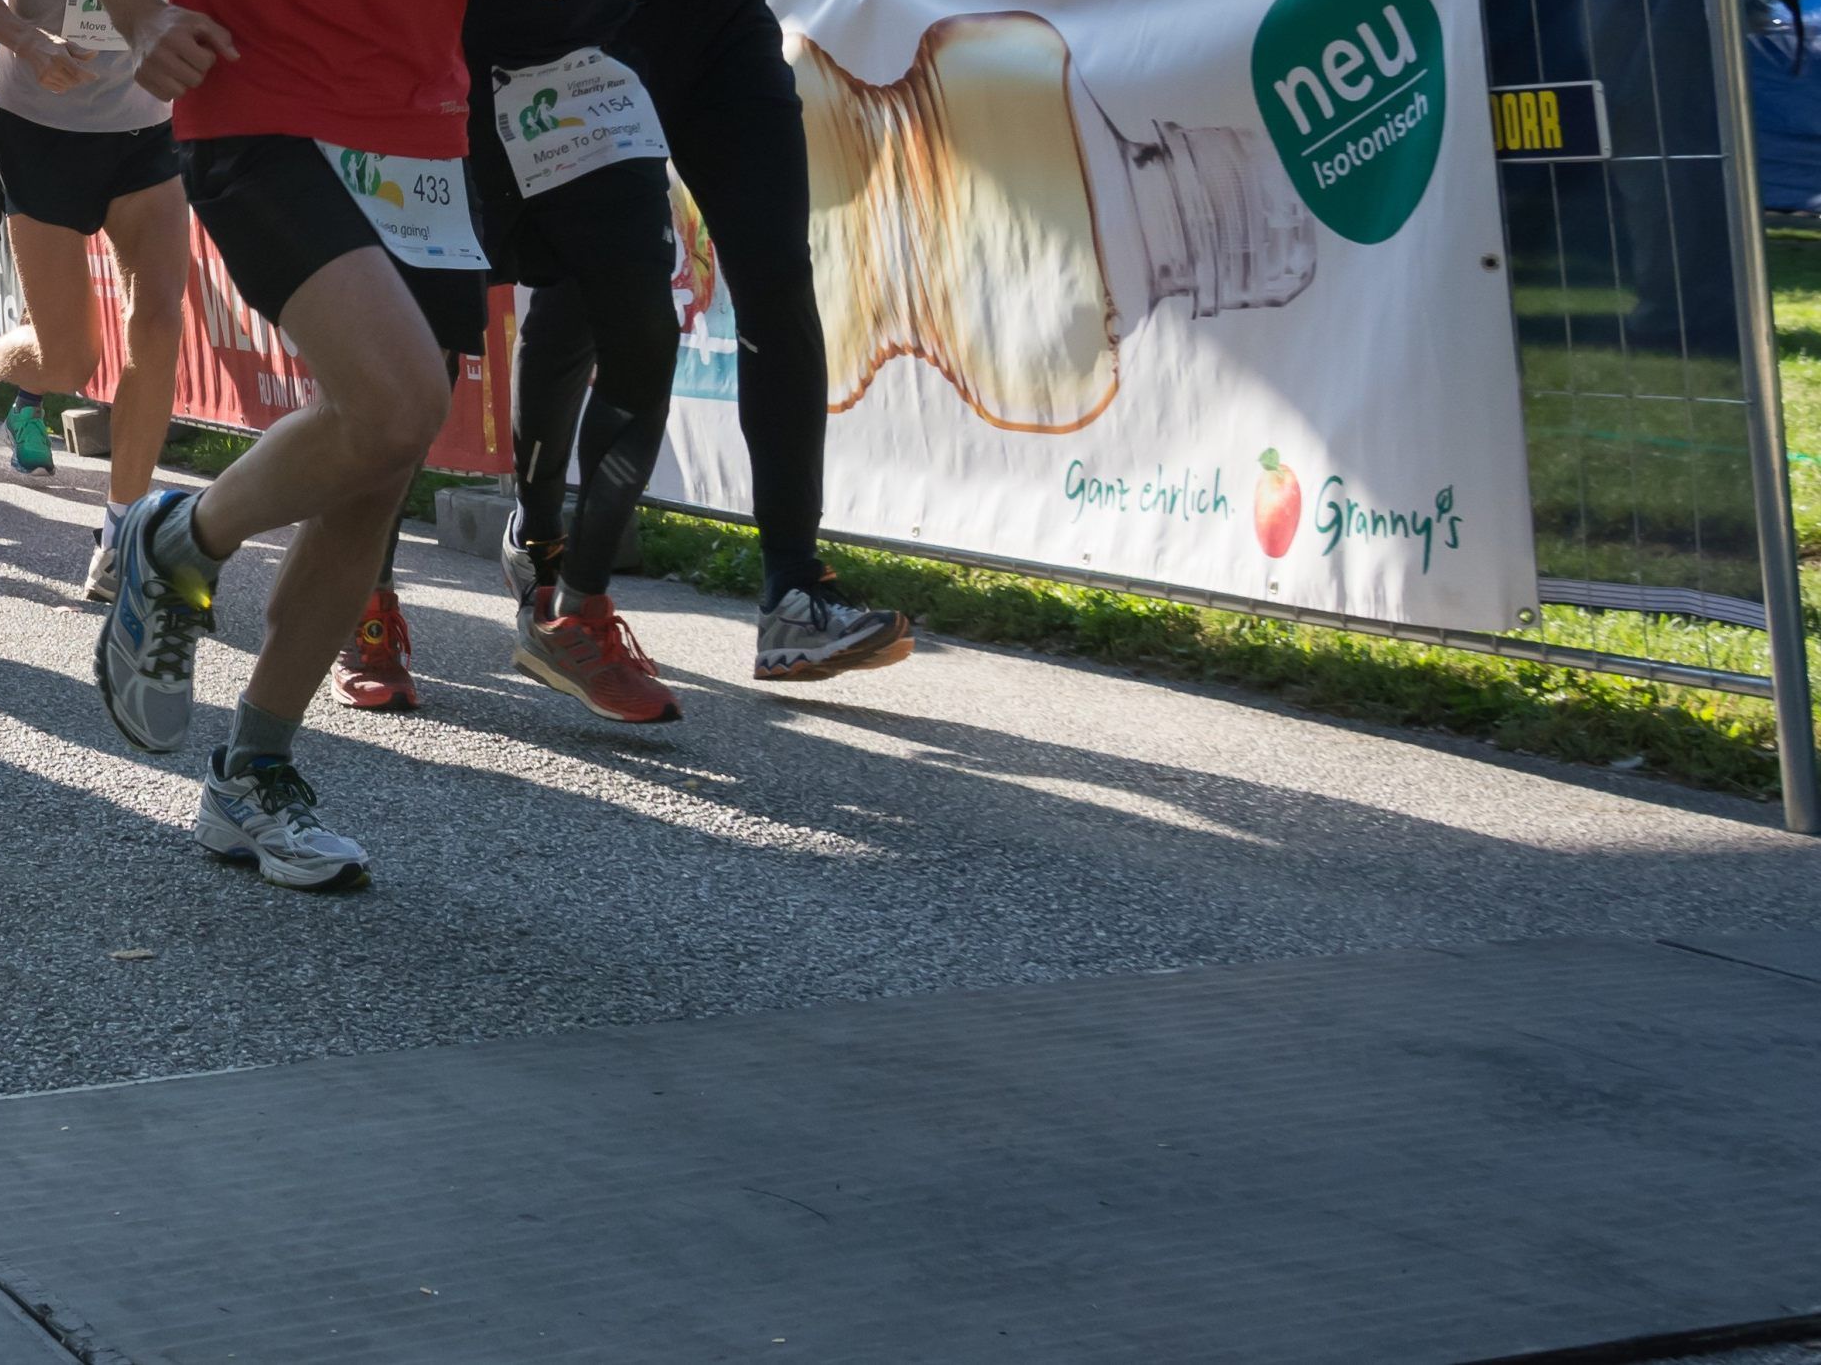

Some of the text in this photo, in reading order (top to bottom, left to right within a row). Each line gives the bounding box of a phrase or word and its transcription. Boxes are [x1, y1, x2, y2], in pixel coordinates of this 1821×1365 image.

[80, 20, 107, 32] Move
[1273, 4, 1418, 135] neu
[566, 76, 601, 91] Vienna
[571, 78, 626, 98] Charity Run
[587, 95, 635, 117] 1154
[533, 122, 641, 165] Move To Change!
[1311, 91, 1428, 189] Isotonisch
[413, 173, 451, 206] 433
[400, 225, 430, 241] going!
[1064, 459, 1236, 523] Ganz ehrlich.
